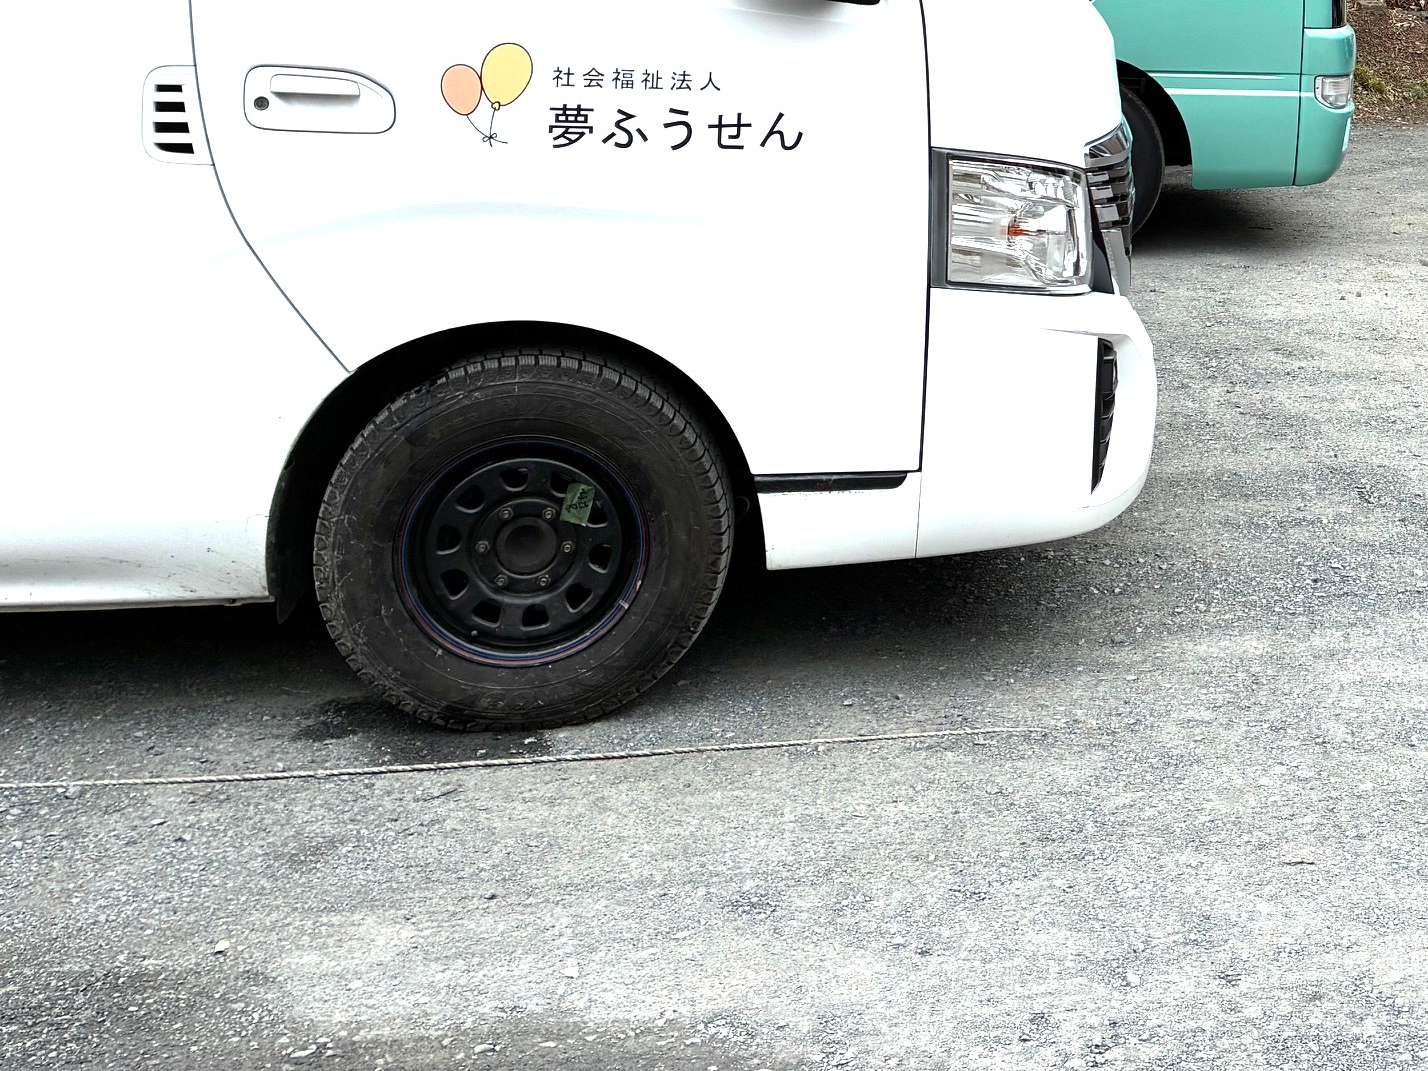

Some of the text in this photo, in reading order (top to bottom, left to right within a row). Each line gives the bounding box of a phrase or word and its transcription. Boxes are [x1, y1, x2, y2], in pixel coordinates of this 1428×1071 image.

[552, 65, 721, 92] 社会福祉法人
[548, 103, 804, 151] 夢ふうせん
